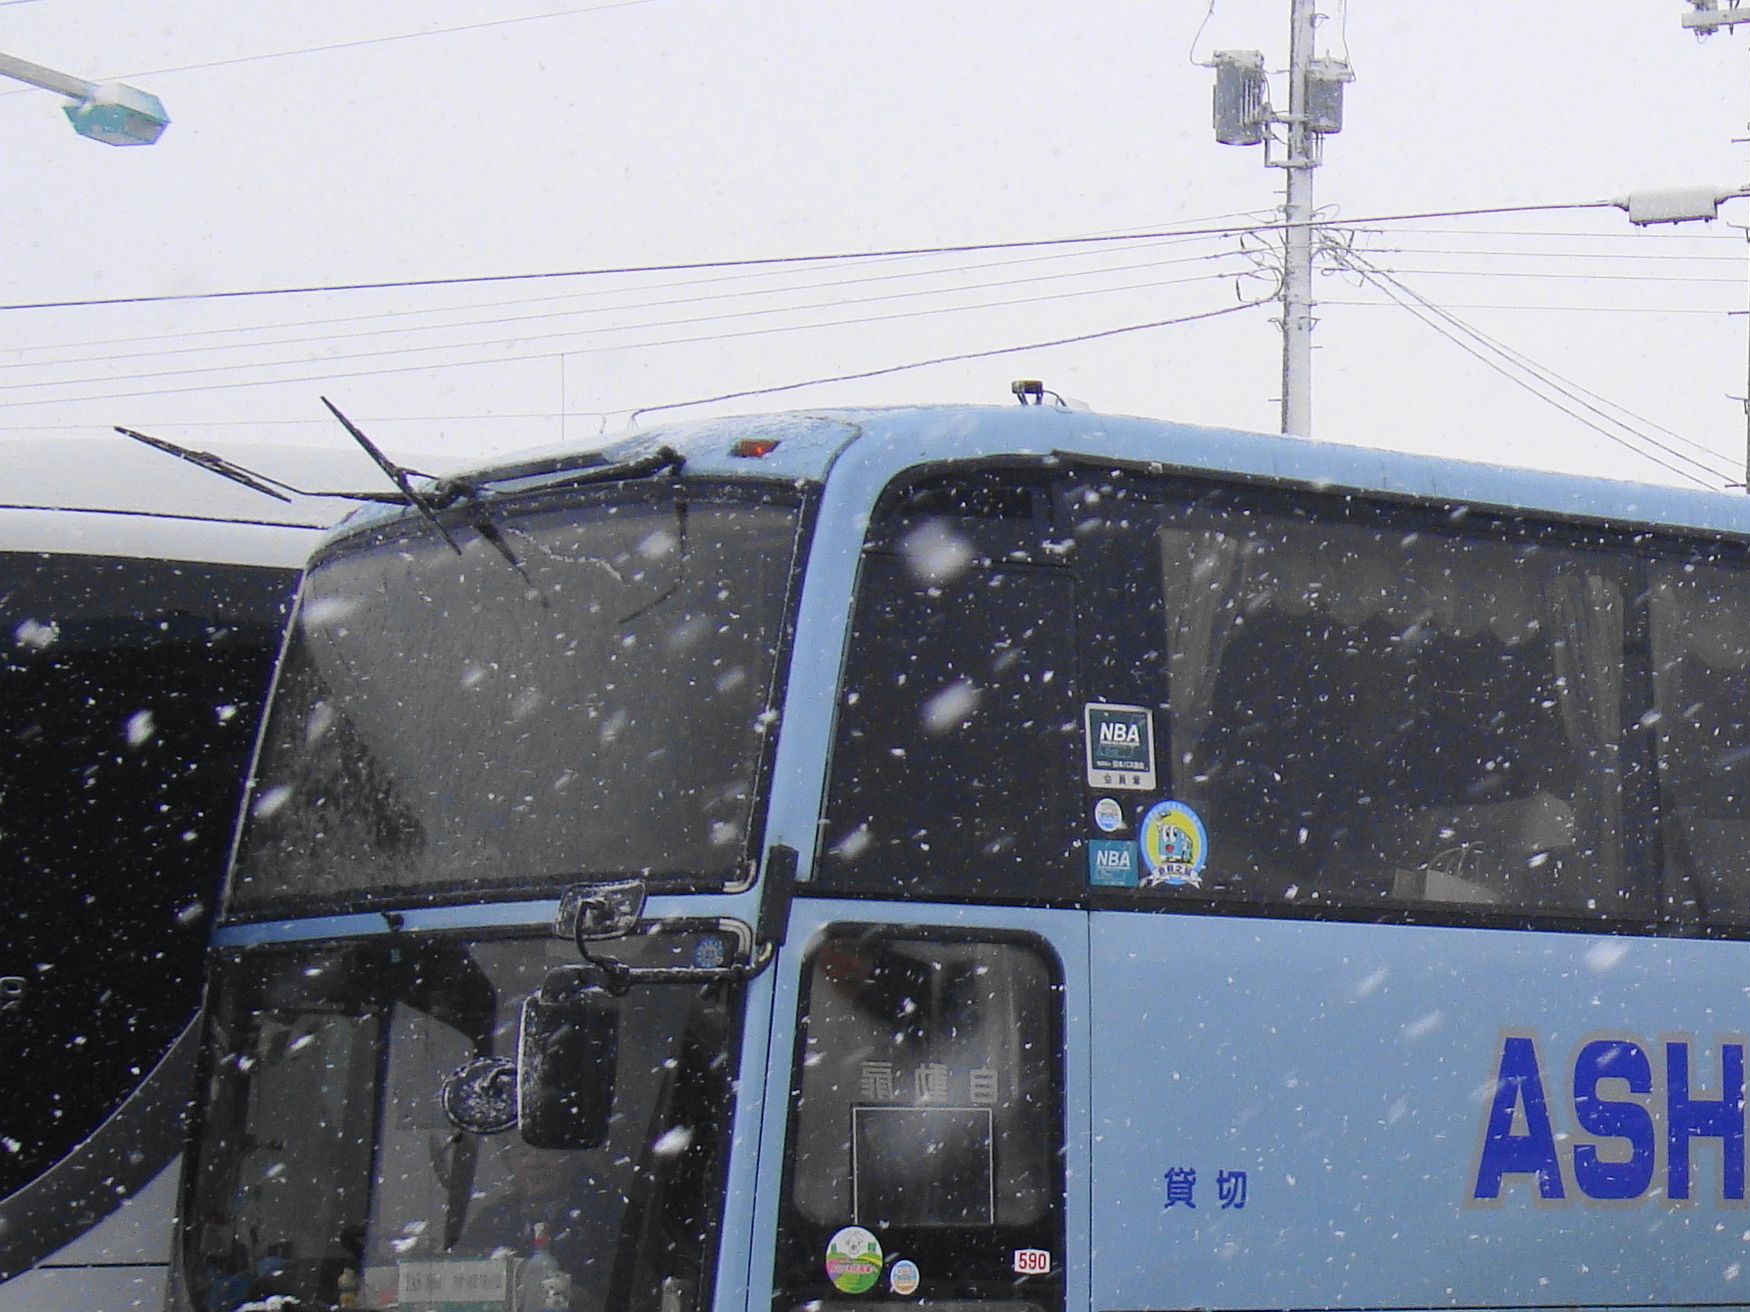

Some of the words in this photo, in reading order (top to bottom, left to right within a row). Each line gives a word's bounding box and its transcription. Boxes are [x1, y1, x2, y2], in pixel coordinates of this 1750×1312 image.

[1100, 722, 1140, 742] NBA
[1096, 850, 1131, 867] NBA
[1164, 1167, 1247, 1210] 貸切
[1019, 1252, 1047, 1270] 590
